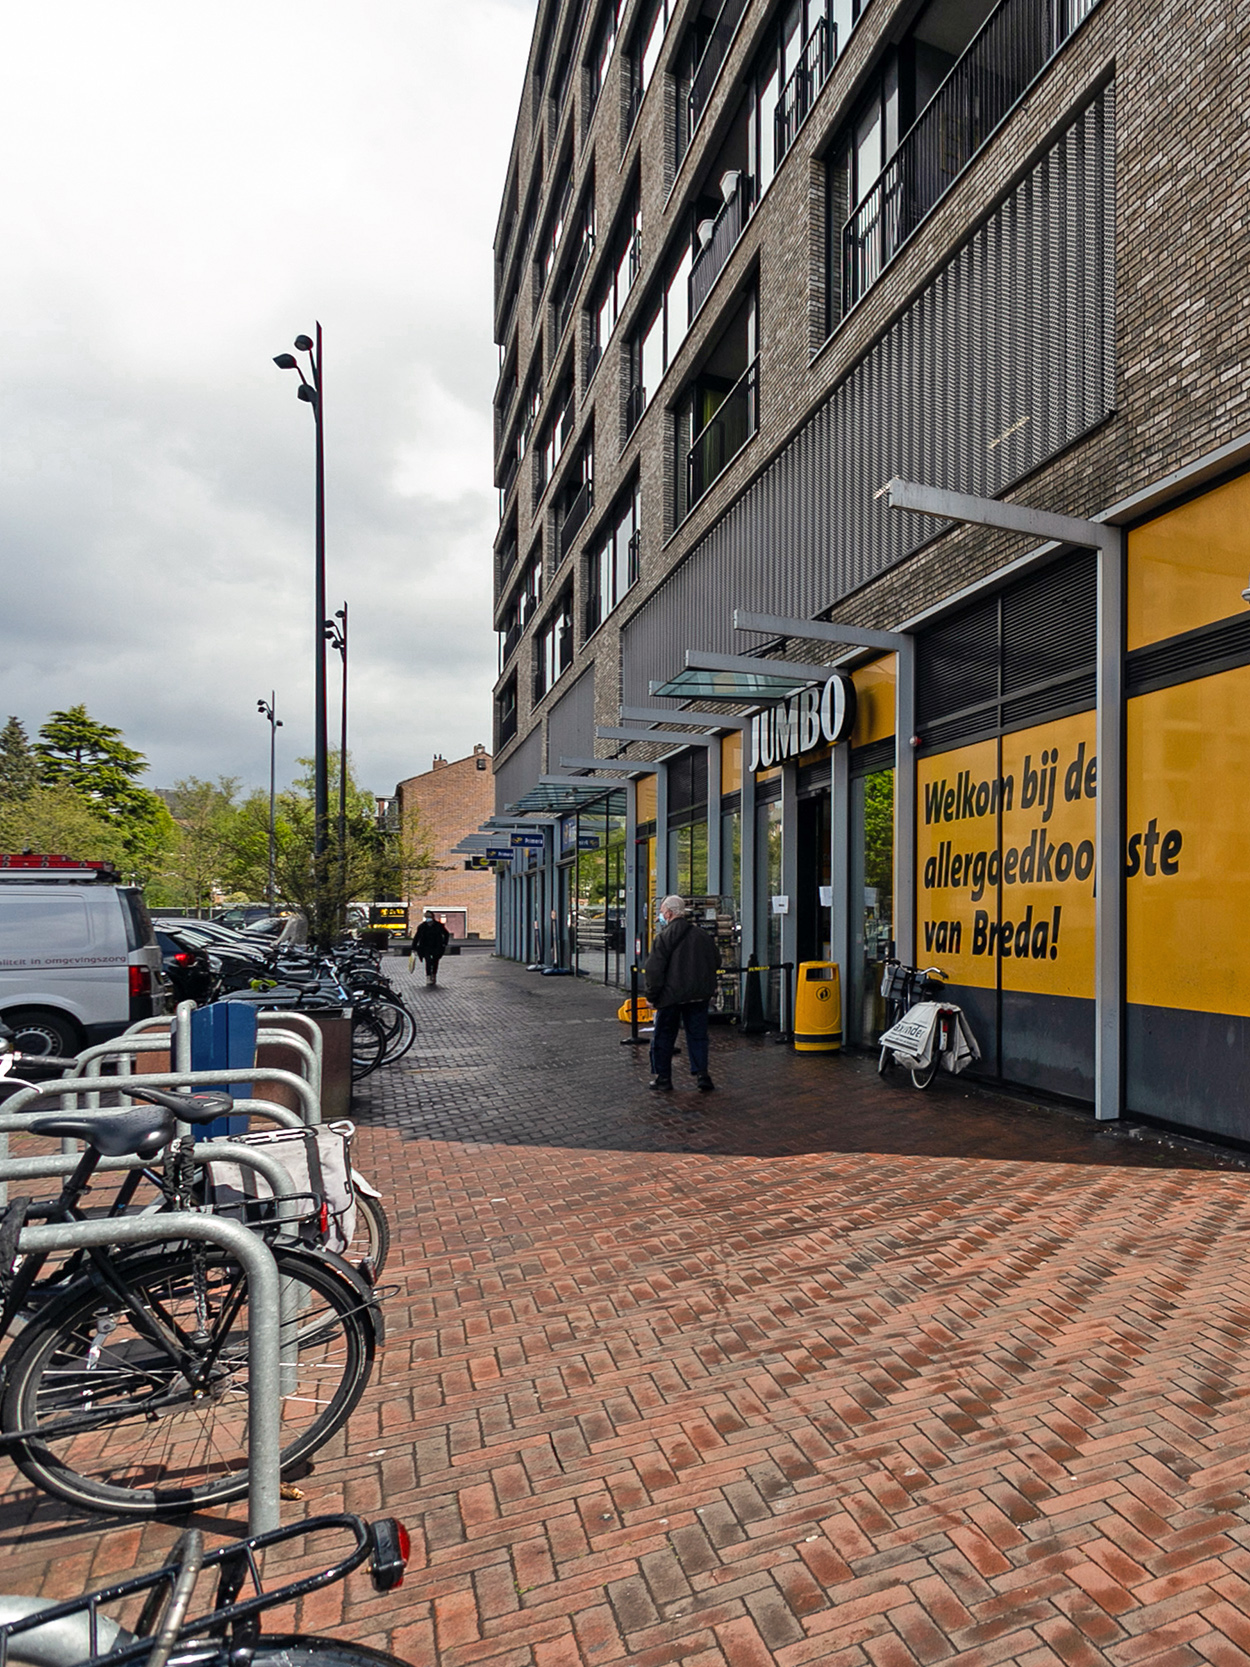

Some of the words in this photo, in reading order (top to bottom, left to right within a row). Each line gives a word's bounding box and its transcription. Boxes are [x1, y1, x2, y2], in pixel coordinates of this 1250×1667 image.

[748, 674, 847, 772] JUMBO
[924, 770, 1015, 825] Welkom
[1020, 748, 1059, 823] bij
[1064, 742, 1097, 802] de
[924, 817, 1183, 902] allergoedkooste
[45, 956, 127, 965] omgevingszorg
[924, 921, 962, 954] van
[972, 905, 1062, 960] Breda!
